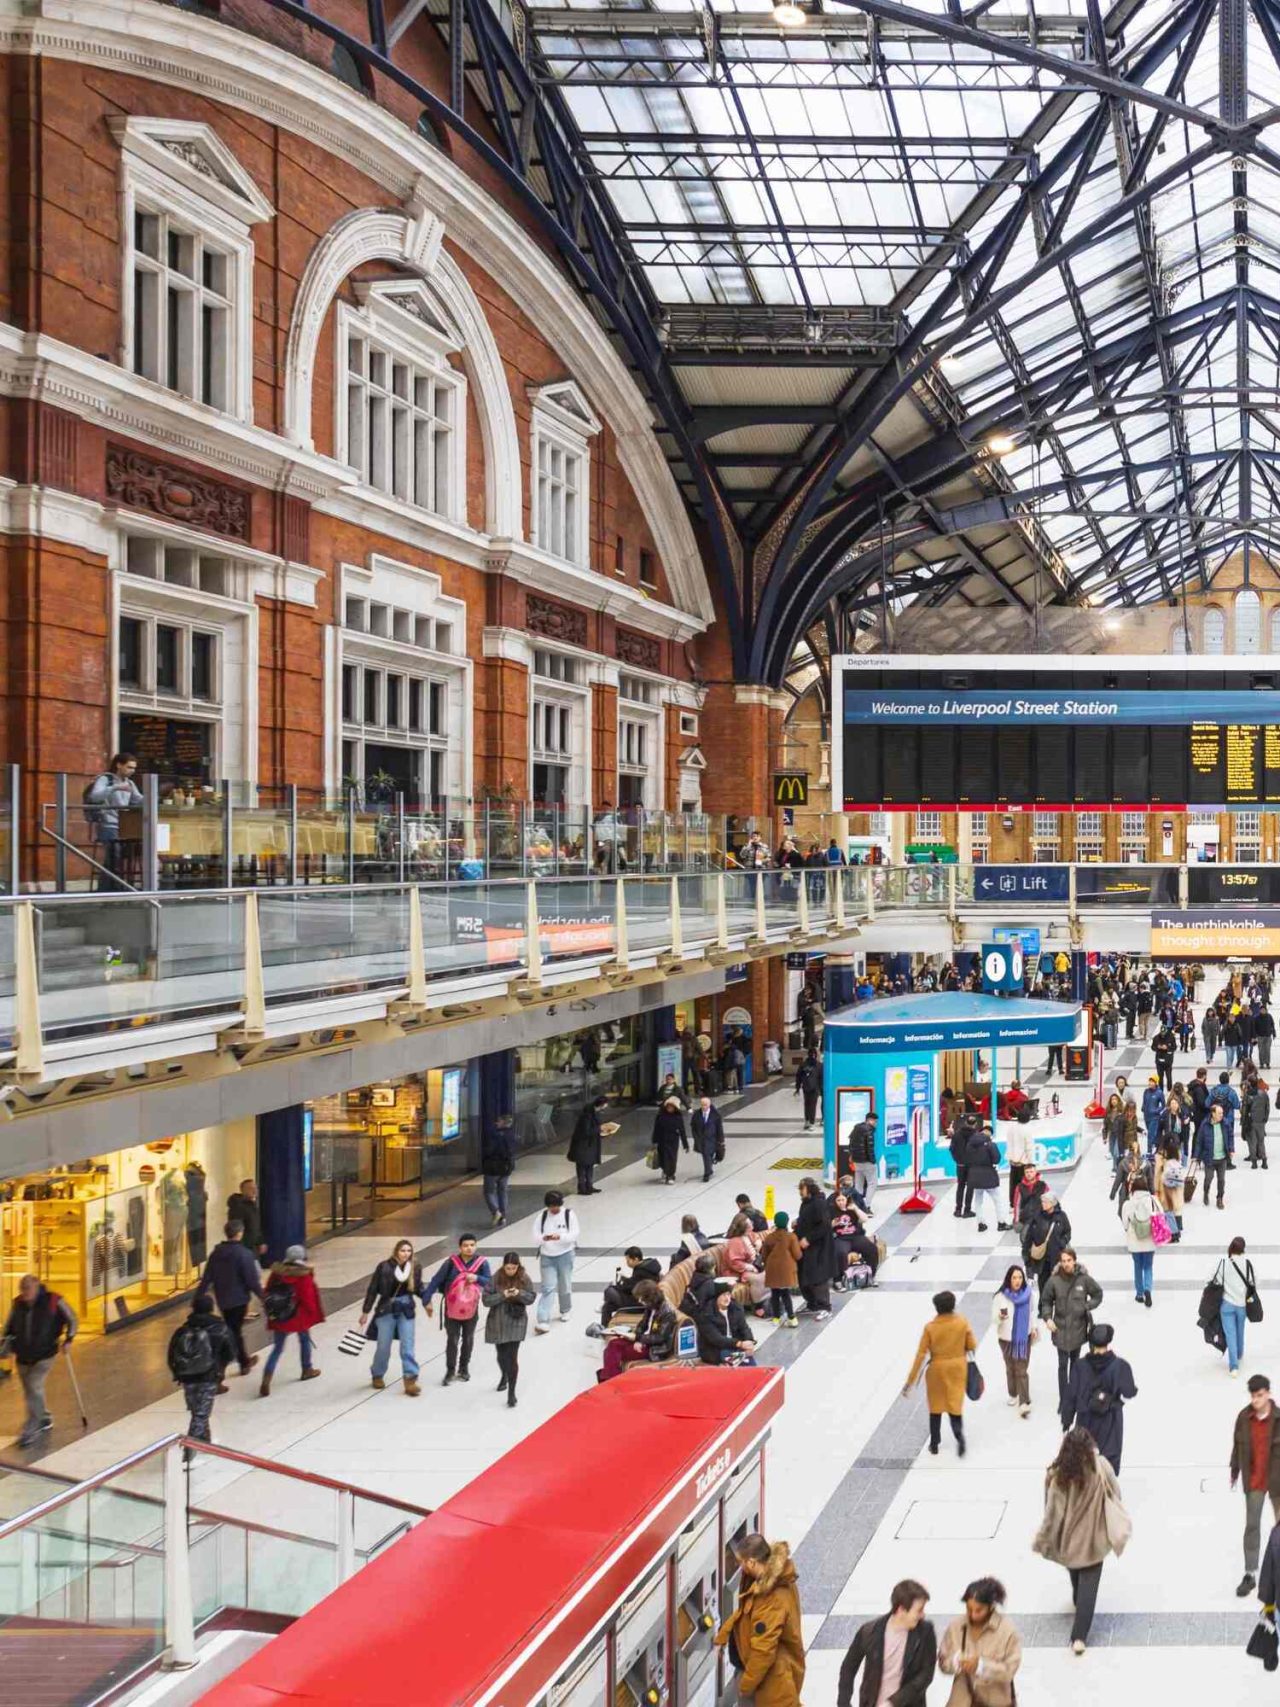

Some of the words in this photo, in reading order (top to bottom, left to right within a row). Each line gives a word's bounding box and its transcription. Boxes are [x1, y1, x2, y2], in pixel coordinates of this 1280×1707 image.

[872, 702, 925, 714] Welcome
[928, 704, 940, 714] to
[943, 701, 1011, 718] Liverpool
[1014, 701, 1060, 714] Street
[1063, 701, 1118, 714] Station
[1023, 876, 1047, 890] Lift
[1222, 874, 1248, 885] 13:57
[1159, 919, 1183, 929] The
[1161, 934, 1216, 948] thought
[953, 1031, 990, 1039] Information
[696, 1456, 724, 1499] Tickets
